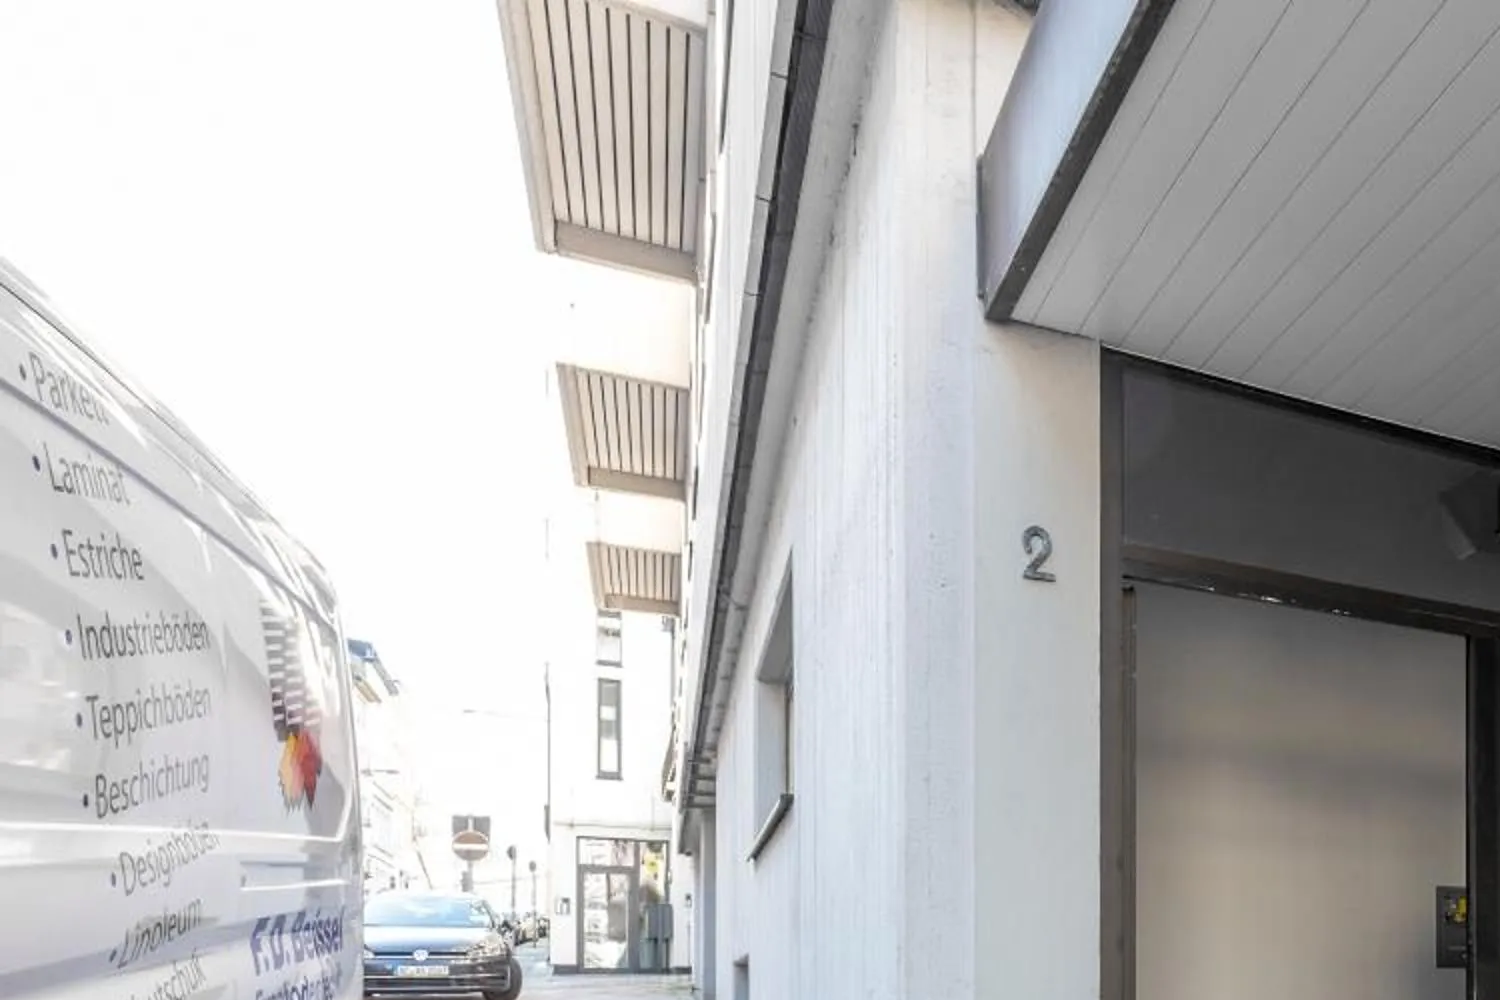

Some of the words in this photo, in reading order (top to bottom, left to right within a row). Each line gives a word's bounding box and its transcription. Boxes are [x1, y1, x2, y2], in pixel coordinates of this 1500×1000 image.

[43, 442, 131, 506] Laminat
[62, 529, 145, 581] Estriche
[1022, 526, 1056, 582] 2
[76, 610, 212, 661] Industrieböden
[85, 679, 213, 749] Teppichböden
[95, 754, 209, 819] Beschichtung
[117, 898, 203, 969] Linoleum
